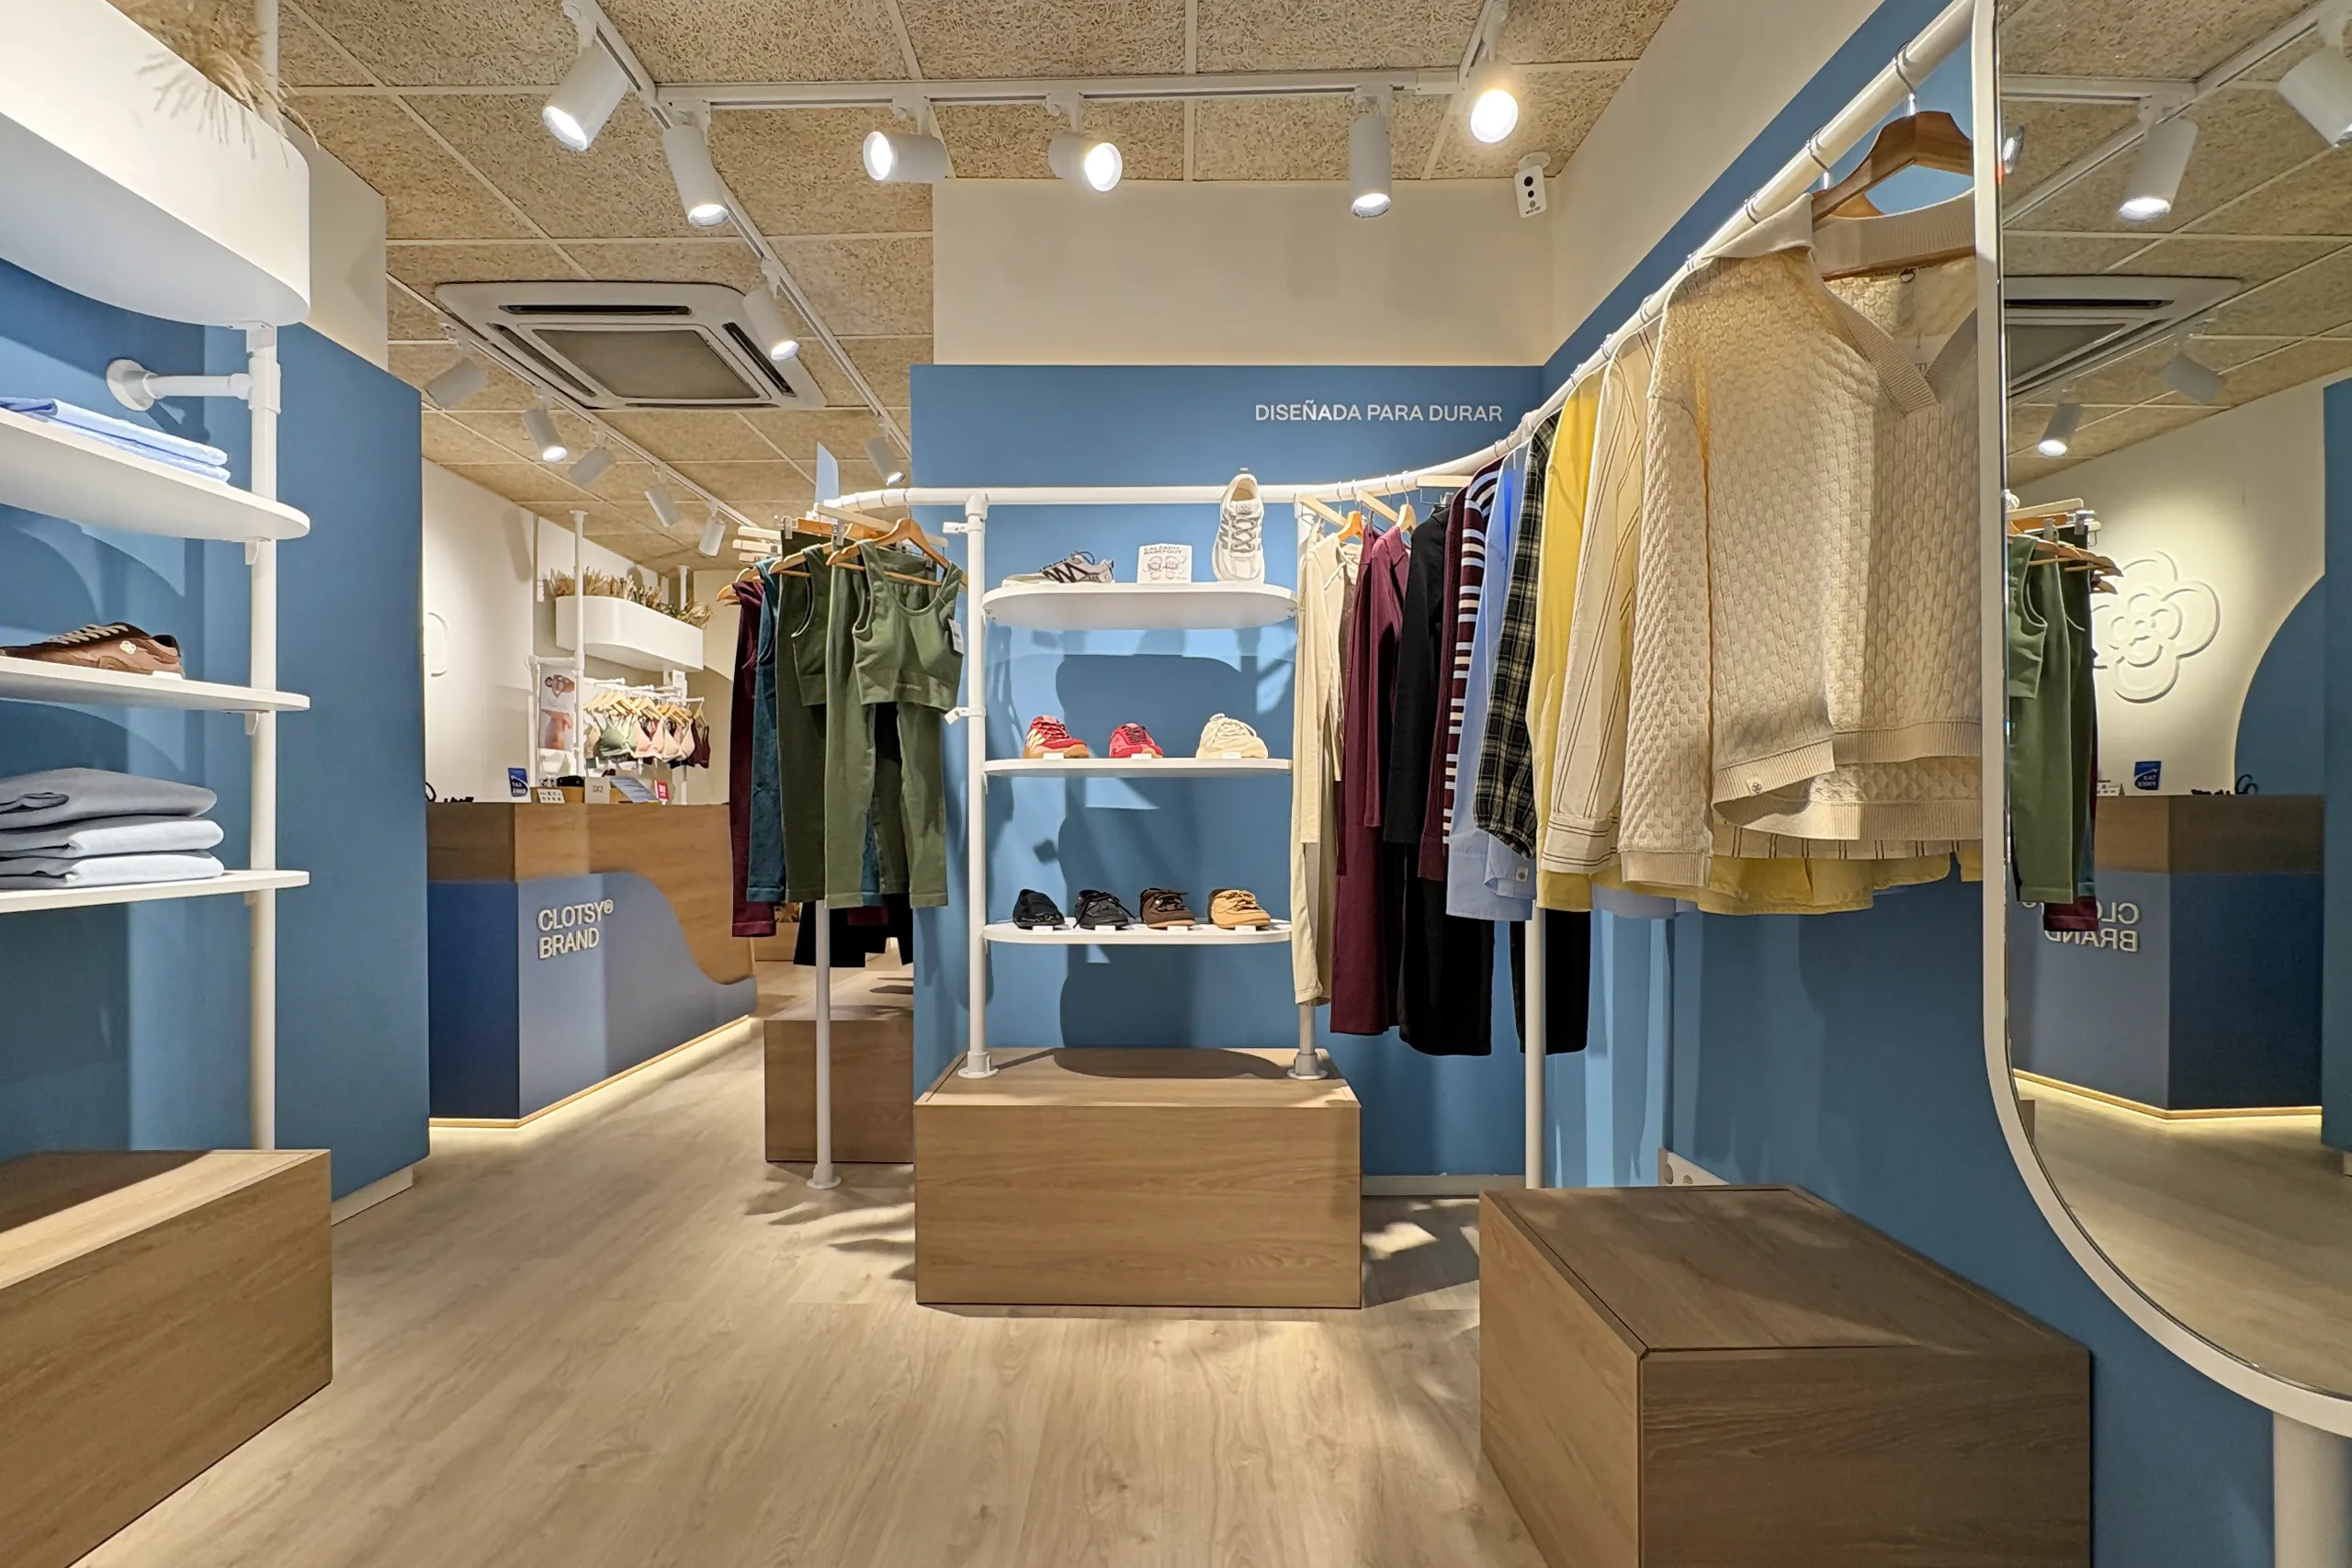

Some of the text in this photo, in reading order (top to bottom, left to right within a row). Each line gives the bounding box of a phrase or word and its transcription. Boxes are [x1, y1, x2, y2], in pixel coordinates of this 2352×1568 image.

[1255, 399, 1503, 423] DISEÑADA PARA DURAR
[538, 927, 600, 959] BRAND
